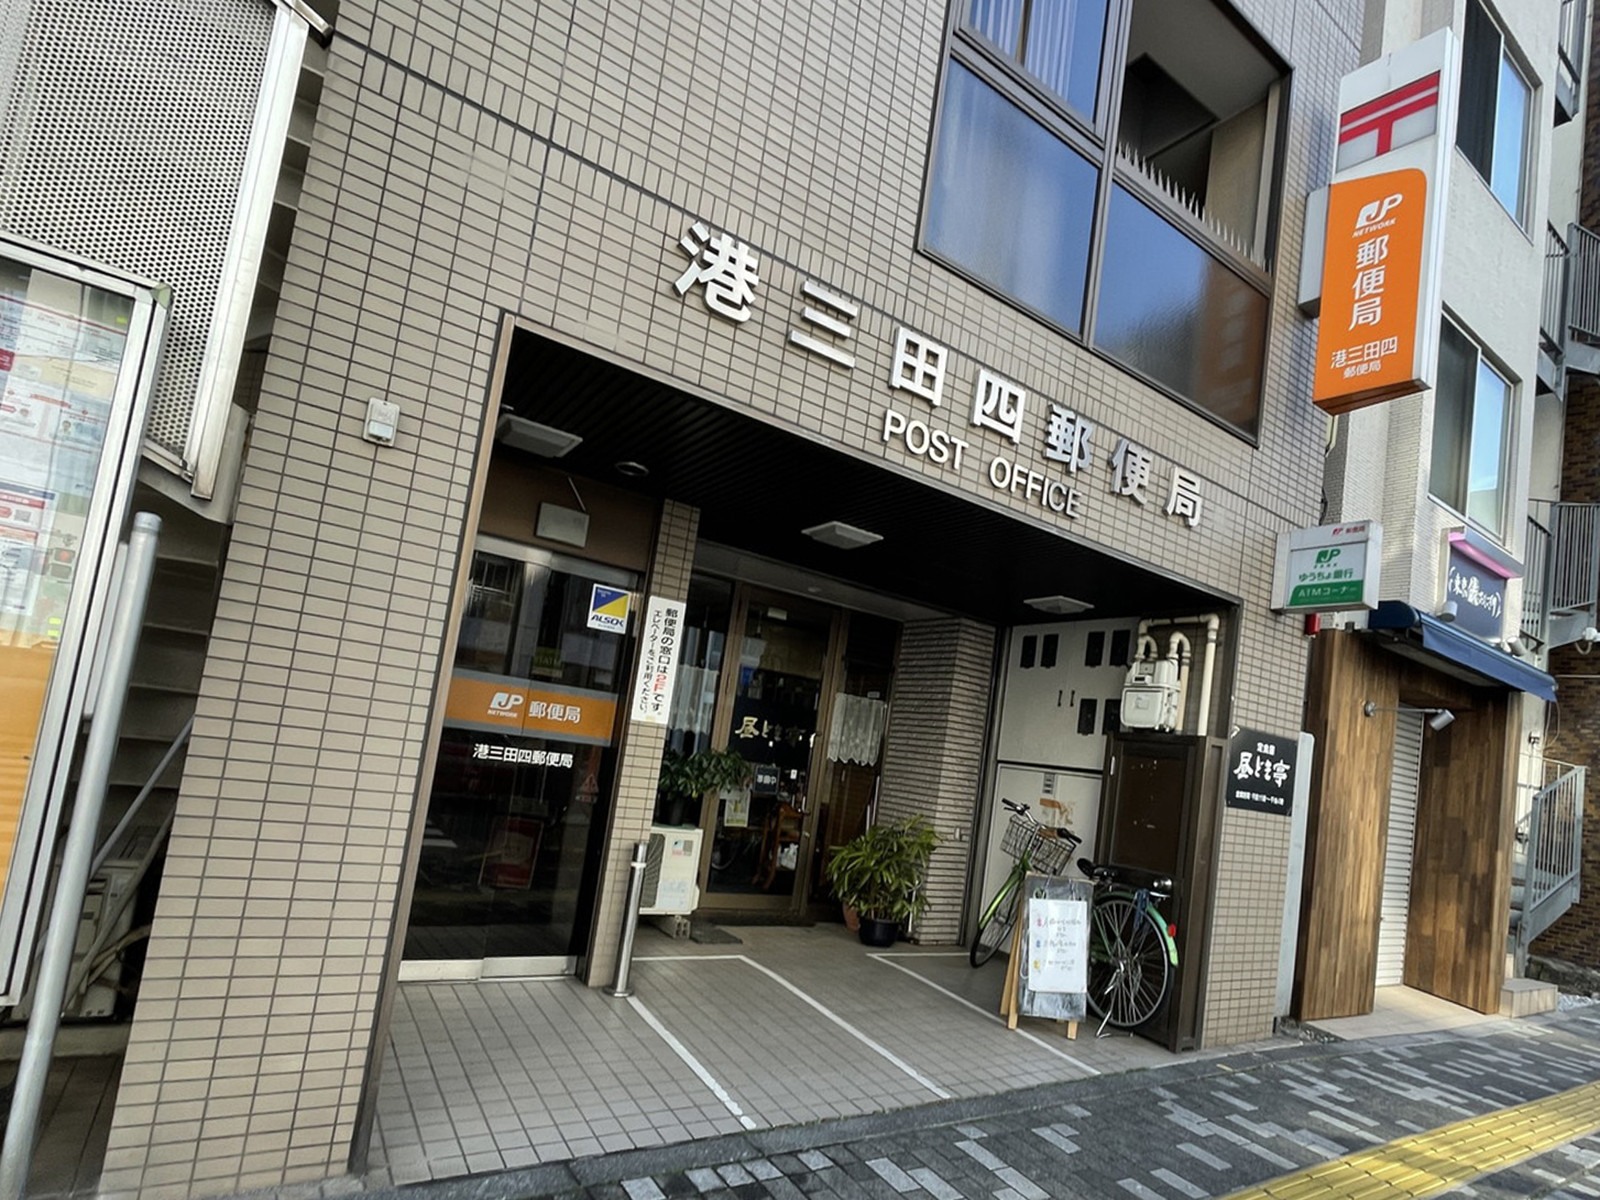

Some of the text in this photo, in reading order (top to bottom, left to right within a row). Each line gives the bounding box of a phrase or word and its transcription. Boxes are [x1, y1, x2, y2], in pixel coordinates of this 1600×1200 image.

[1352, 217, 1397, 238] NETWORK
[1349, 234, 1390, 331] 郵便局
[1331, 336, 1398, 369] 港三田四
[672, 221, 1203, 528] 港三田四郵便局
[1343, 360, 1382, 380] 郵便局
[882, 408, 1083, 519] POST OFFICE
[1298, 568, 1354, 582] ゆうちょ銀行
[1298, 586, 1357, 598] ATMコーナー
[591, 614, 625, 628] ALSOK
[528, 700, 581, 724] 郵便局
[472, 743, 574, 769] 港三田四郵便局
